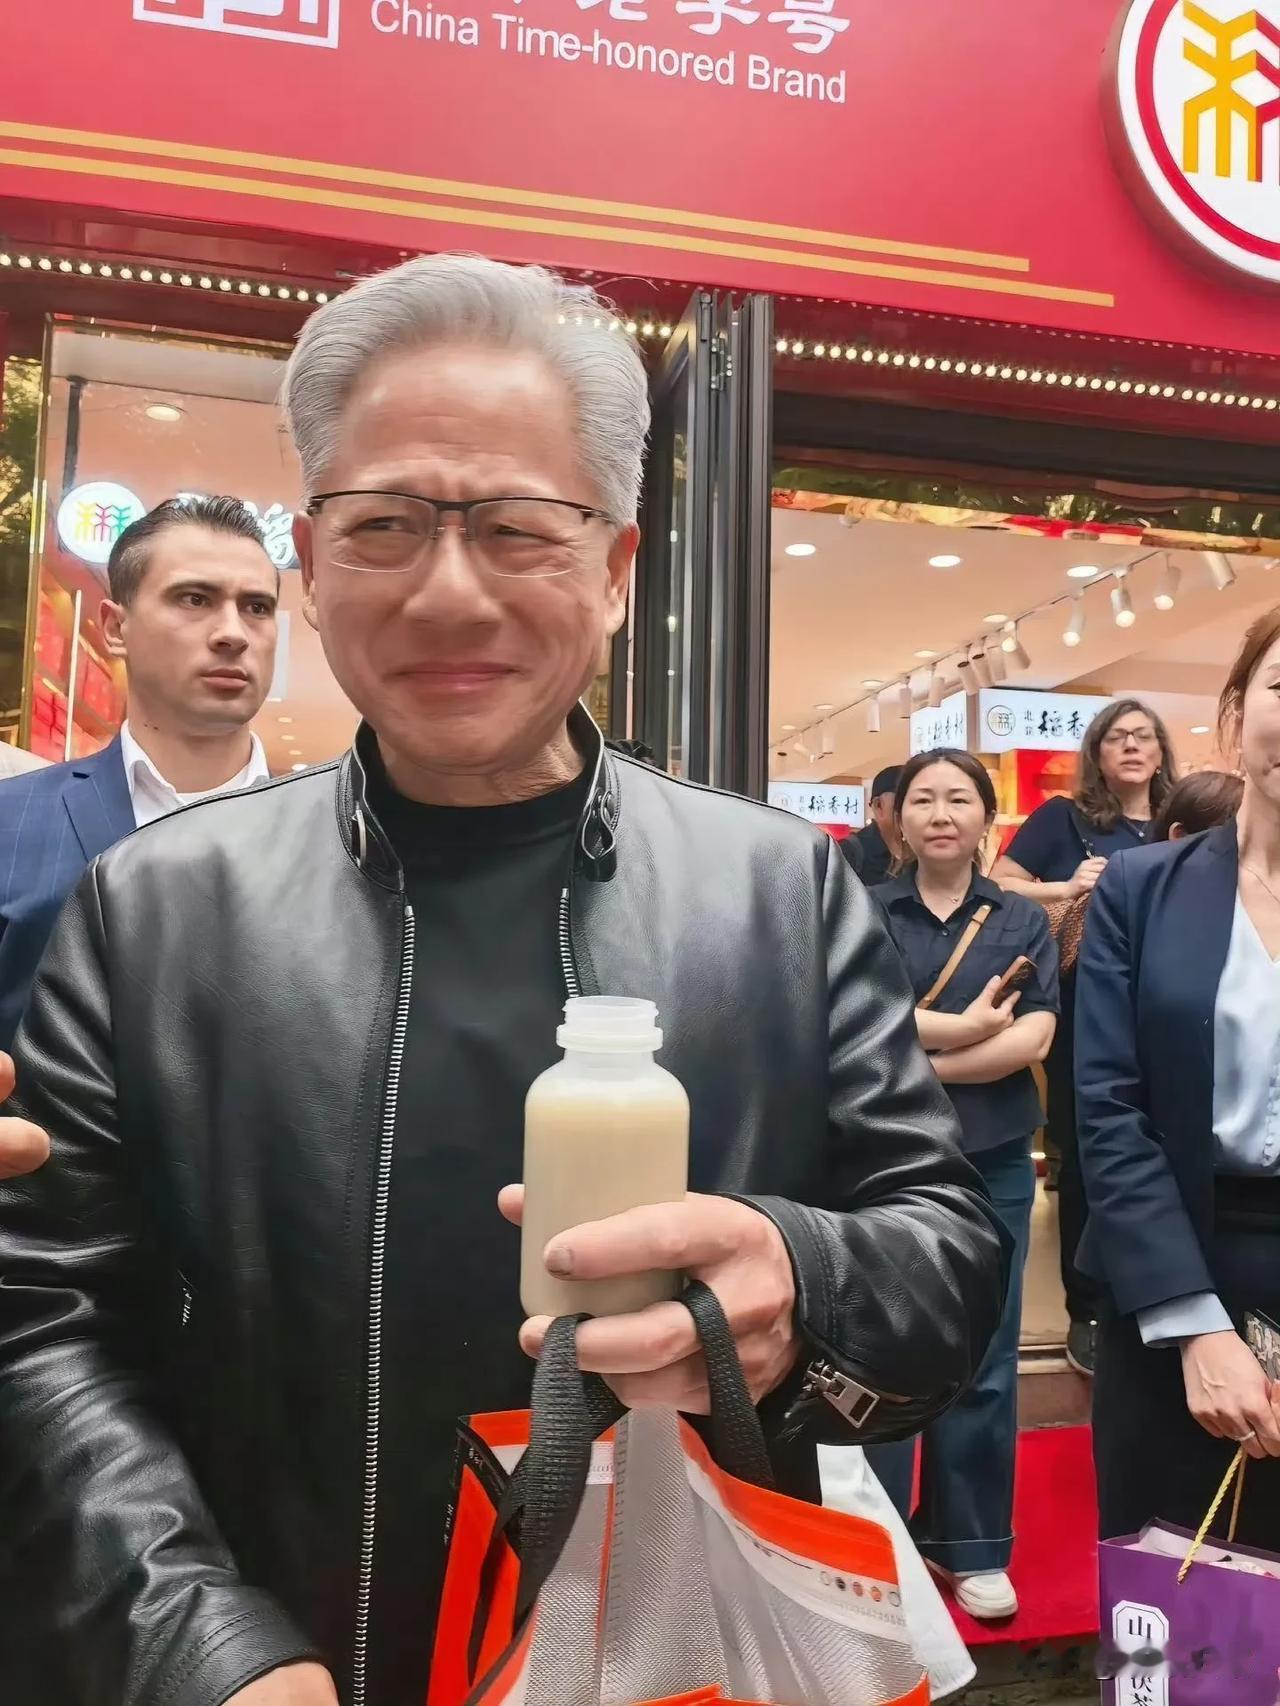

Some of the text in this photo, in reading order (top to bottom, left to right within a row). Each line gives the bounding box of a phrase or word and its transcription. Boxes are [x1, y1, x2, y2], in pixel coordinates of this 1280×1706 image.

[370, 0, 479, 46] China
[491, 13, 735, 86] Time-honored
[747, 54, 846, 104] Brand
[1037, 710, 1097, 739] 稻香
